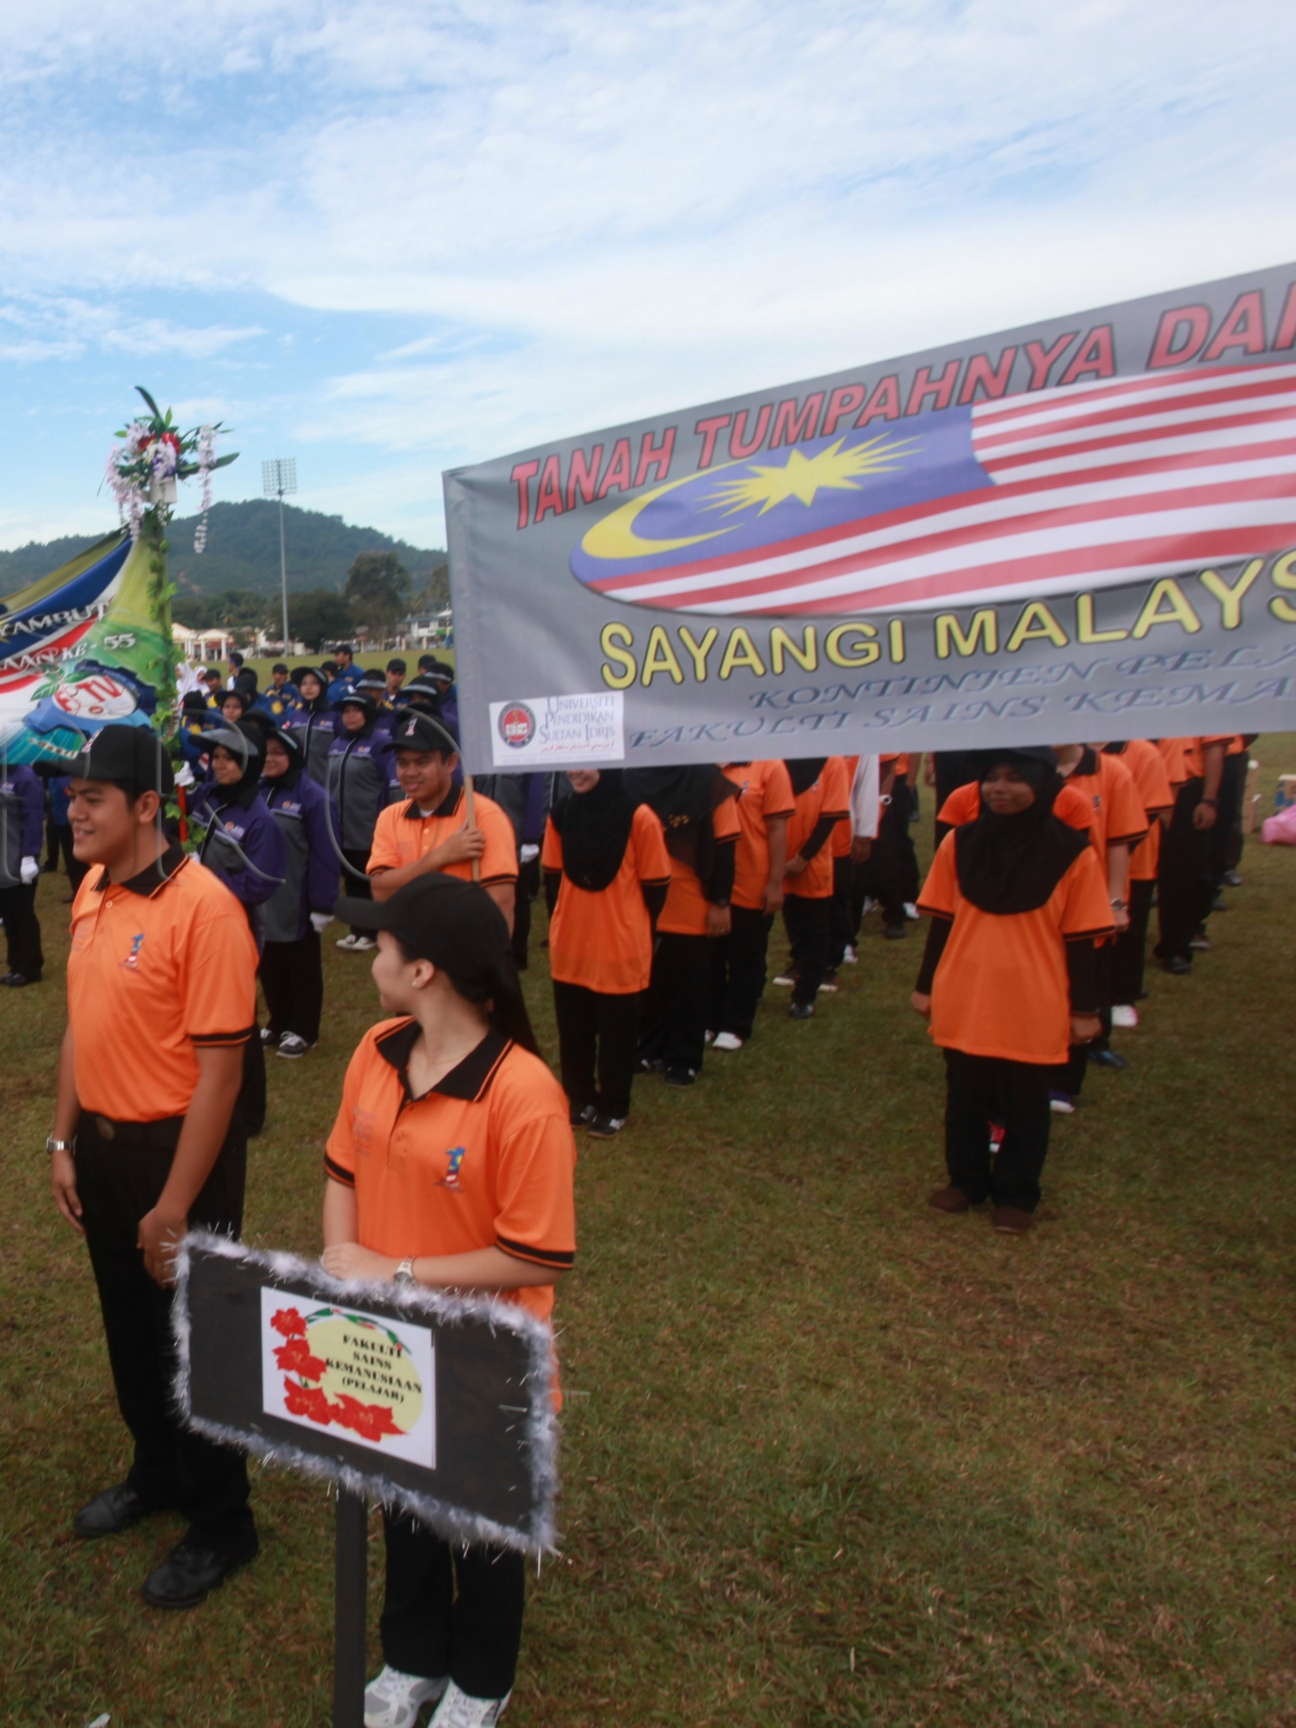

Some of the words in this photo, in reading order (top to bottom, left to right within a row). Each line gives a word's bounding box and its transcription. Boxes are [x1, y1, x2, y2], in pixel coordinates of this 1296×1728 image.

[510, 425, 678, 531] TANAH
[693, 324, 1116, 470] TUMPAHNYA
[104, 632, 136, 650] 55
[599, 617, 905, 690] SAYANGI
[539, 725, 582, 744] SULTAN
[585, 724, 616, 742] IDRIS
[627, 710, 855, 748] FAKULTI
[862, 693, 1046, 728] SAINS
[342, 1334, 402, 1359] FAKULTI
[353, 1351, 392, 1370] SAINS
[325, 1357, 422, 1393] KEMANUSIAAN
[342, 1376, 405, 1403] (PELAJAR)
